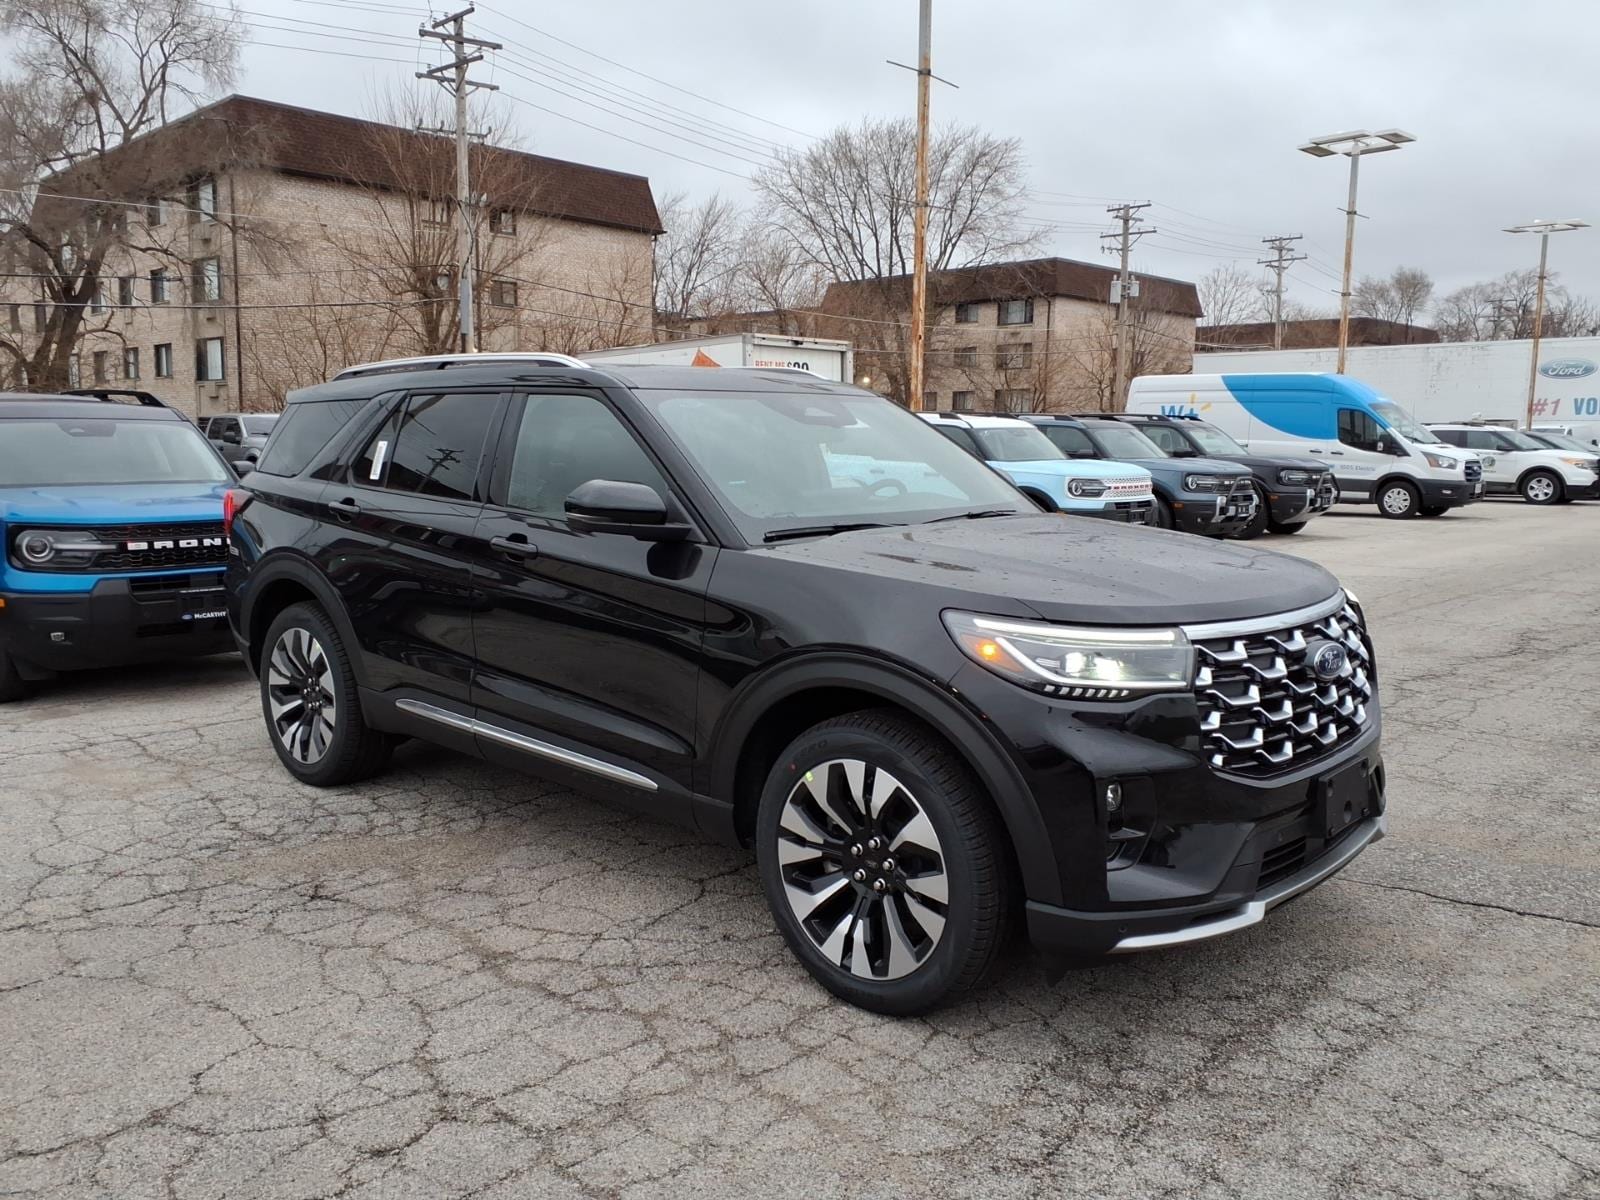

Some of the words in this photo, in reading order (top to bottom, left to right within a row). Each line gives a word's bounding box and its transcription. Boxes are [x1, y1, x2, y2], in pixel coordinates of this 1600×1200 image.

[1548, 361, 1585, 376] Ford
[1532, 398, 1561, 416] #1
[1573, 397, 1600, 416] VO
[127, 538, 231, 550] BRON
